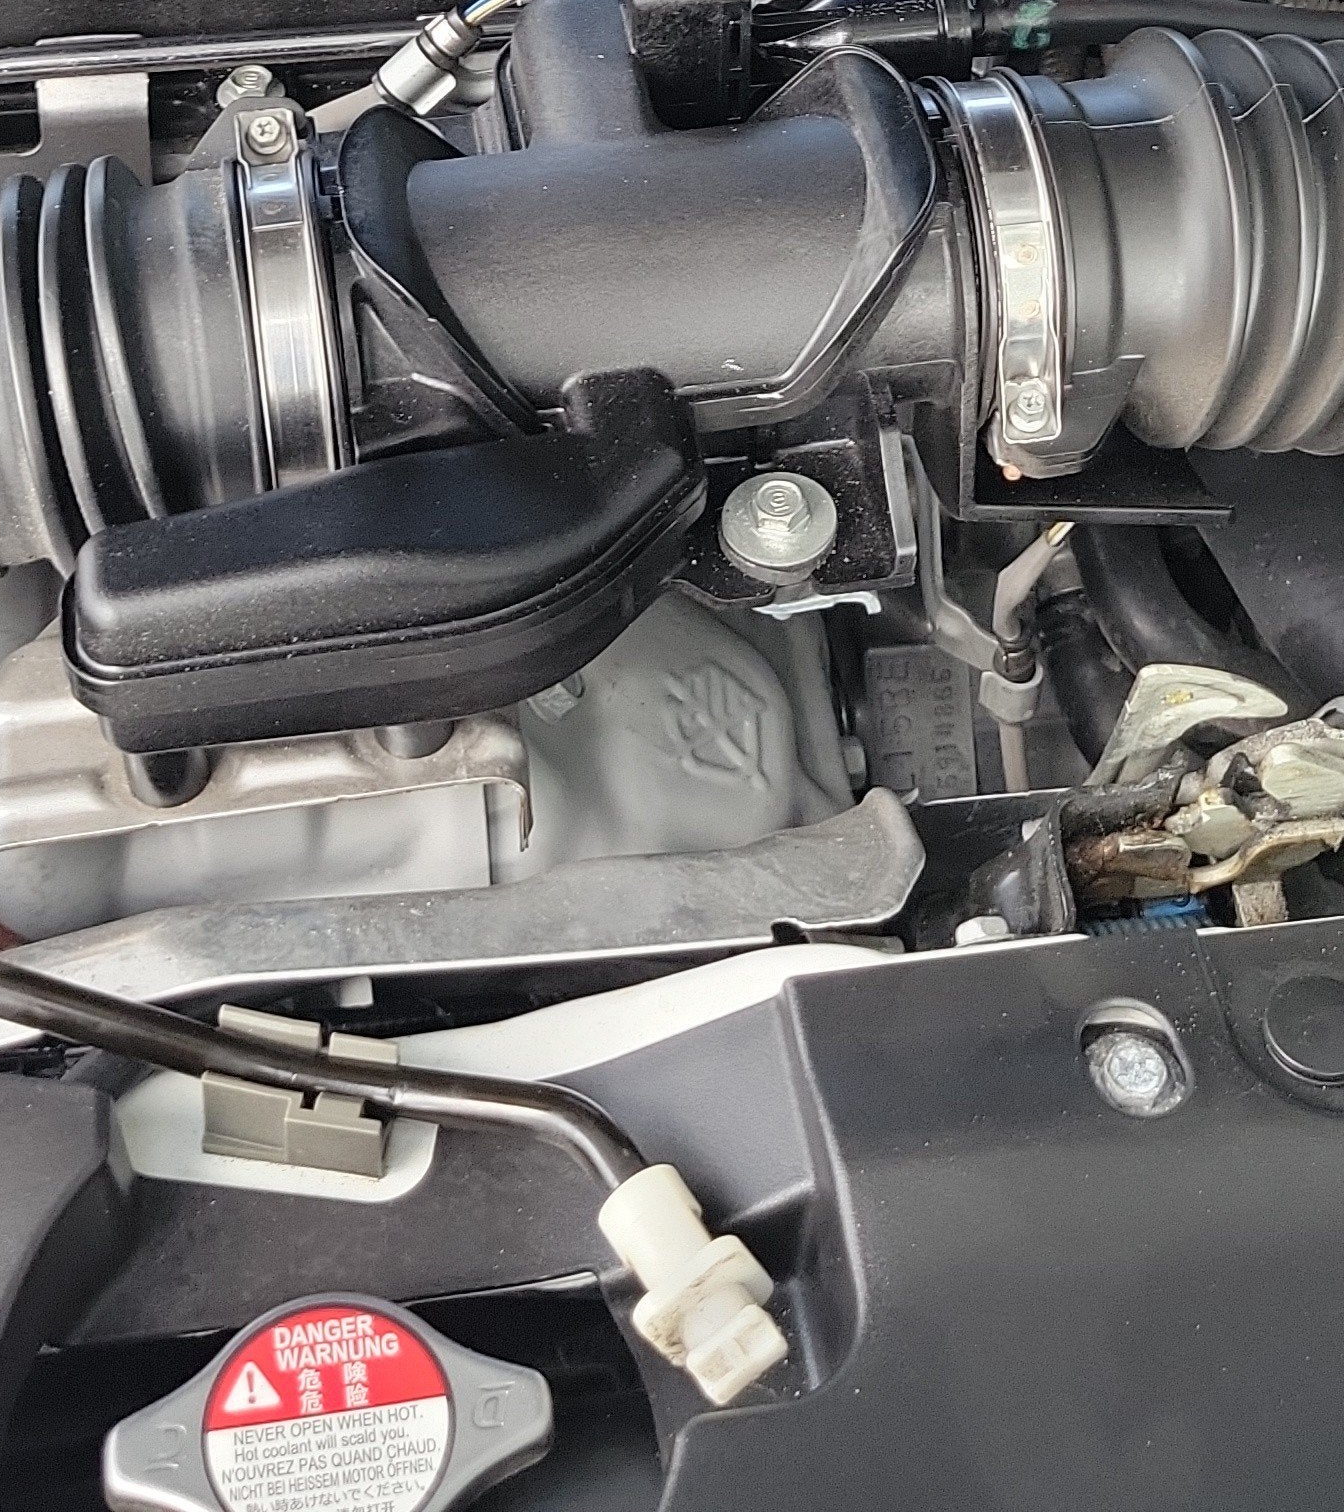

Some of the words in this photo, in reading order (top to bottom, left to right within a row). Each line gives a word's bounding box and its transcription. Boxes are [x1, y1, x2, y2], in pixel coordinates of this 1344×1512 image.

[273, 1314, 375, 1349] DANGER
[275, 1332, 400, 1372] WARNUNG
[233, 1423, 286, 1446] NEVER
[290, 1417, 334, 1438] OPEN
[337, 1409, 384, 1430] WHEN
[387, 1404, 424, 1423] HOT.
[221, 1460, 294, 1484] N'OUVREZ
[299, 1454, 328, 1472] PAS
[331, 1445, 383, 1468] QUAND
[386, 1438, 441, 1460] CHAUD.
[234, 1447, 259, 1463] Hot
[262, 1439, 312, 1459] coolant
[315, 1435, 337, 1450] will
[341, 1429, 377, 1447] scald
[381, 1426, 410, 1445] you.
[229, 1482, 264, 1502] NICHT
[267, 1480, 286, 1496] BEI
[288, 1474, 340, 1494] HEISSEM
[342, 1467, 384, 1488] MOTOR
